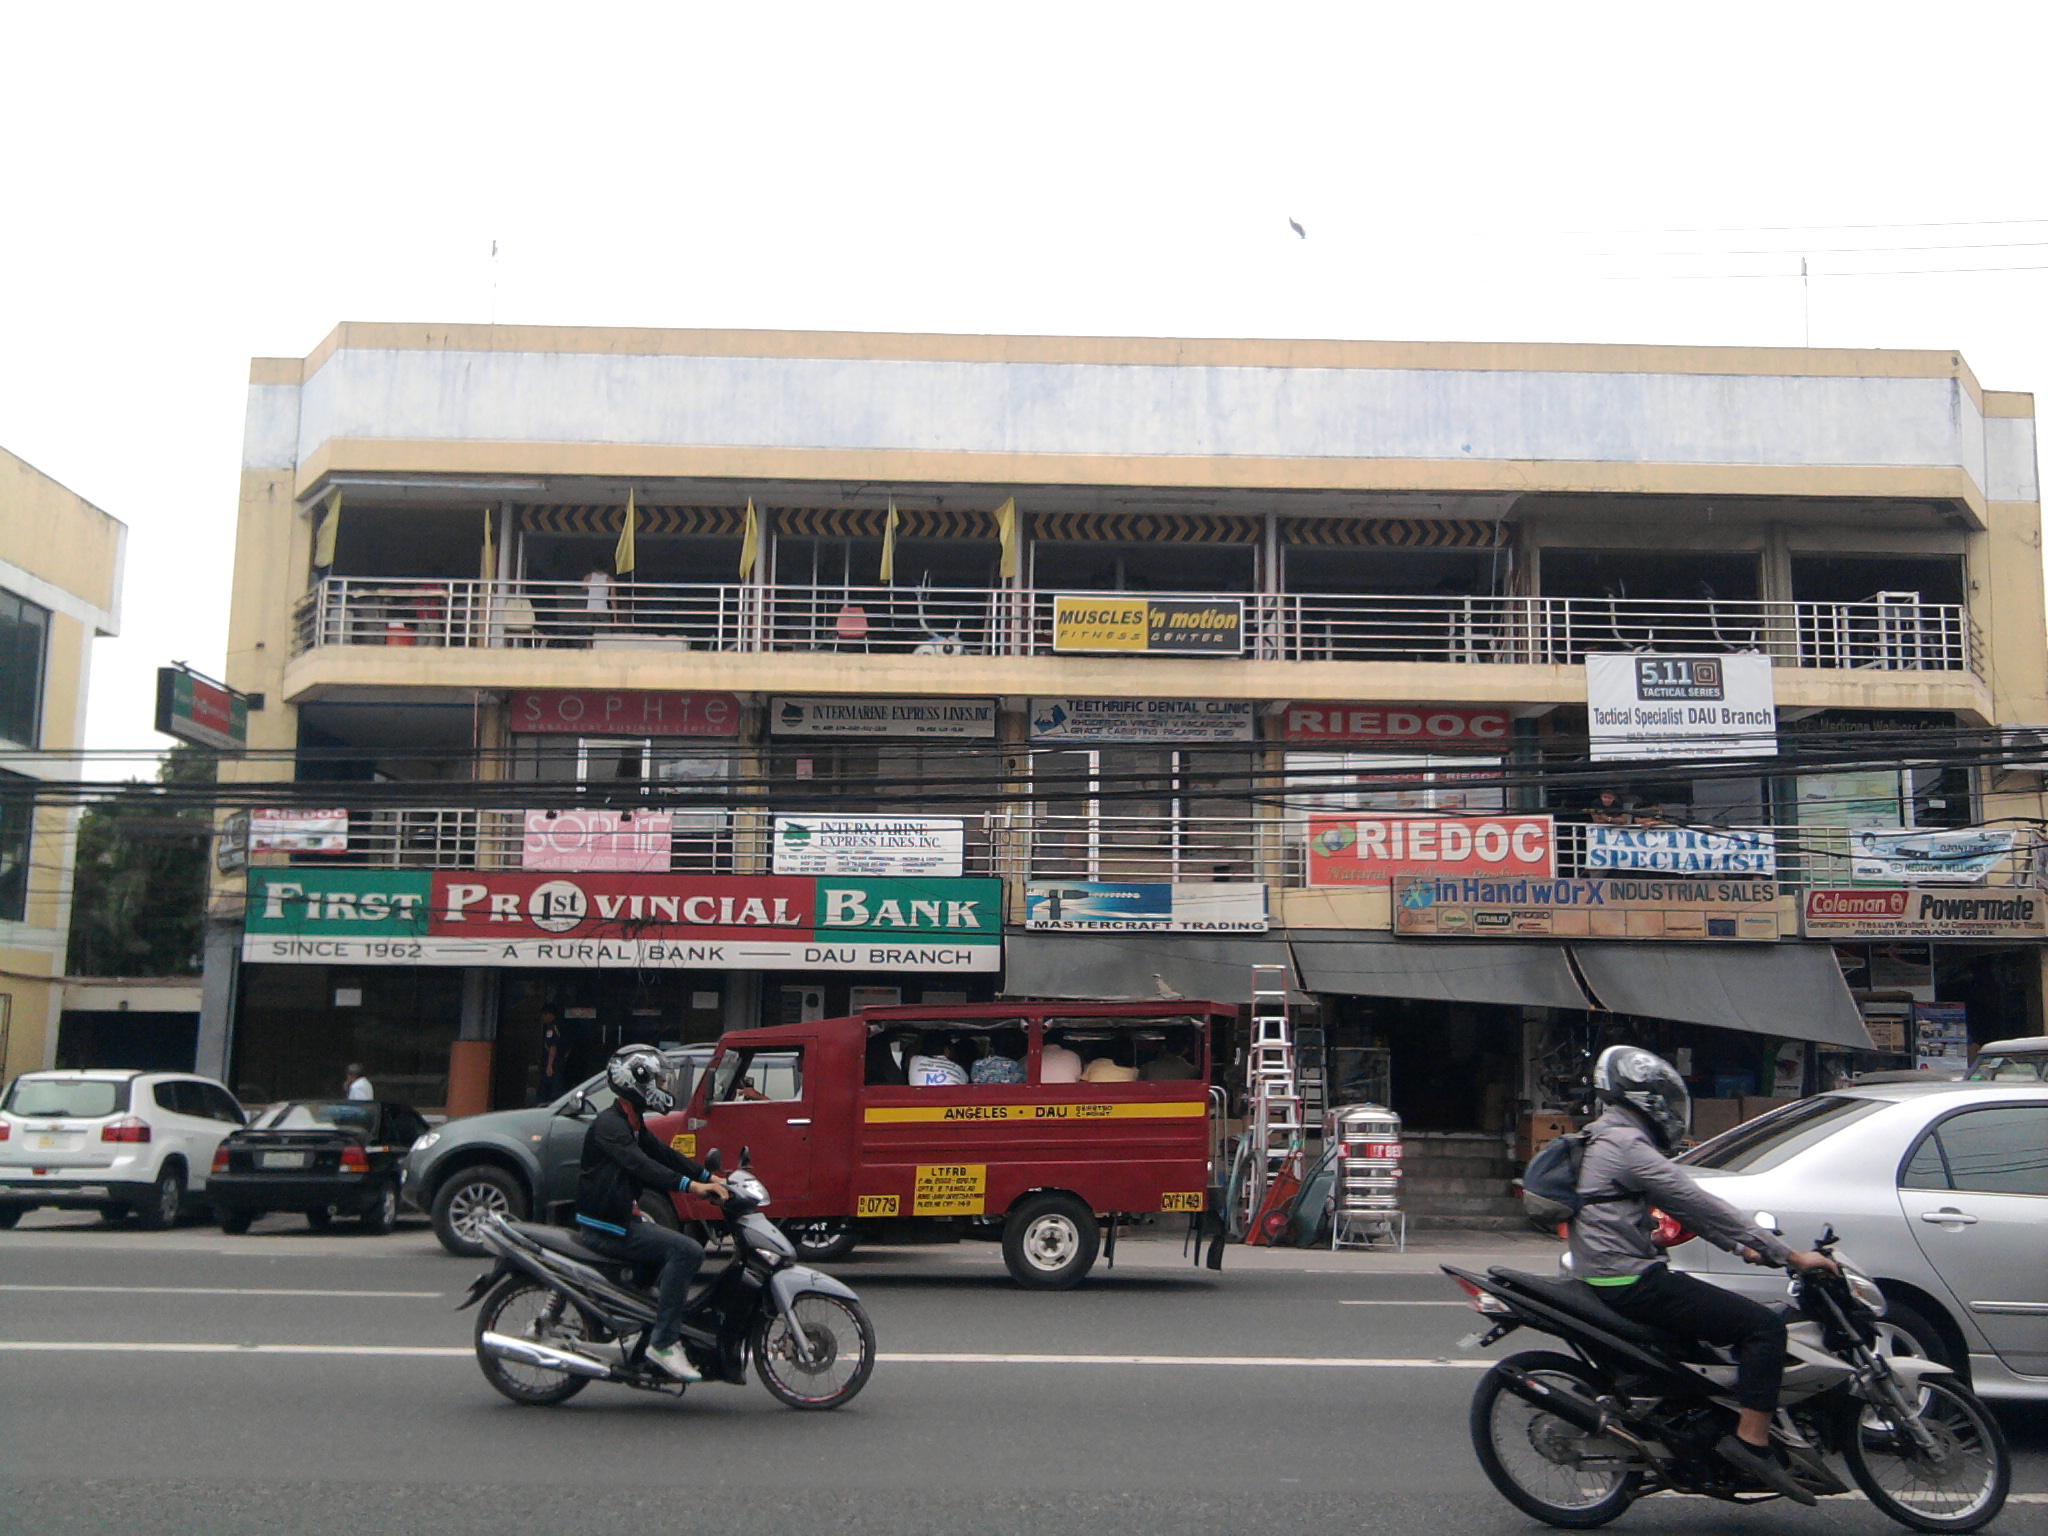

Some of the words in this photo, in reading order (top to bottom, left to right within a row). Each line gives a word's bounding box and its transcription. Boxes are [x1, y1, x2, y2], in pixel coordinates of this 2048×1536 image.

[1058, 610, 1143, 625] MUSCLES
[1169, 608, 1238, 629] motion
[1060, 630, 1142, 641] FITNESS
[1150, 632, 1224, 643] CENTER
[1640, 661, 1692, 686] 5.11
[1642, 687, 1687, 698] TACTICAL
[1687, 687, 1721, 698] SERIES
[813, 705, 888, 721] INTERMARINE
[892, 707, 940, 721] EXPRESS
[1066, 700, 1144, 713] TEETHRIFIC
[1148, 701, 1200, 713] DENTAL
[1205, 702, 1250, 715] CLINIC
[1288, 710, 1506, 738] RIEDOC
[1593, 707, 1632, 726] Tactical
[1634, 707, 1684, 729] Specialist
[1688, 708, 1716, 725] DAU
[1721, 708, 1772, 725] Branch
[820, 821, 929, 837] INTERMARINE
[820, 835, 877, 848] EXPRESS
[1355, 820, 1546, 863] RIEDOC
[1588, 827, 1772, 851] TACTICAL
[1589, 848, 1771, 872] SPECIALIST
[1326, 864, 1391, 881] Natural
[1435, 877, 1458, 903] in
[1610, 882, 1716, 902] INDUSTRIAL
[1718, 883, 1775, 903] SALES
[262, 882, 424, 921] FIRST
[822, 888, 983, 929] BANK
[1811, 893, 1887, 914] Coleman
[1919, 894, 2035, 921] Powermate
[1033, 920, 1174, 931] MASTERCRAFT
[1179, 921, 1265, 931] TRADING
[1807, 920, 1850, 929] Generators
[1858, 921, 1895, 929] Pressure
[1938, 921, 1950, 929] Air
[2009, 922, 2022, 930] Air
[272, 940, 350, 957] SINCE
[364, 942, 423, 959] 1962
[502, 944, 519, 959] A
[538, 944, 632, 960] RURAL
[649, 946, 725, 962] BANK
[804, 948, 857, 964] DAU
[869, 949, 973, 965] BRANCH
[944, 1106, 1008, 1120] ANGELES
[1035, 1106, 1068, 1119] DAU
[931, 1167, 967, 1177] LTFRB
[867, 1197, 897, 1213] 0779
